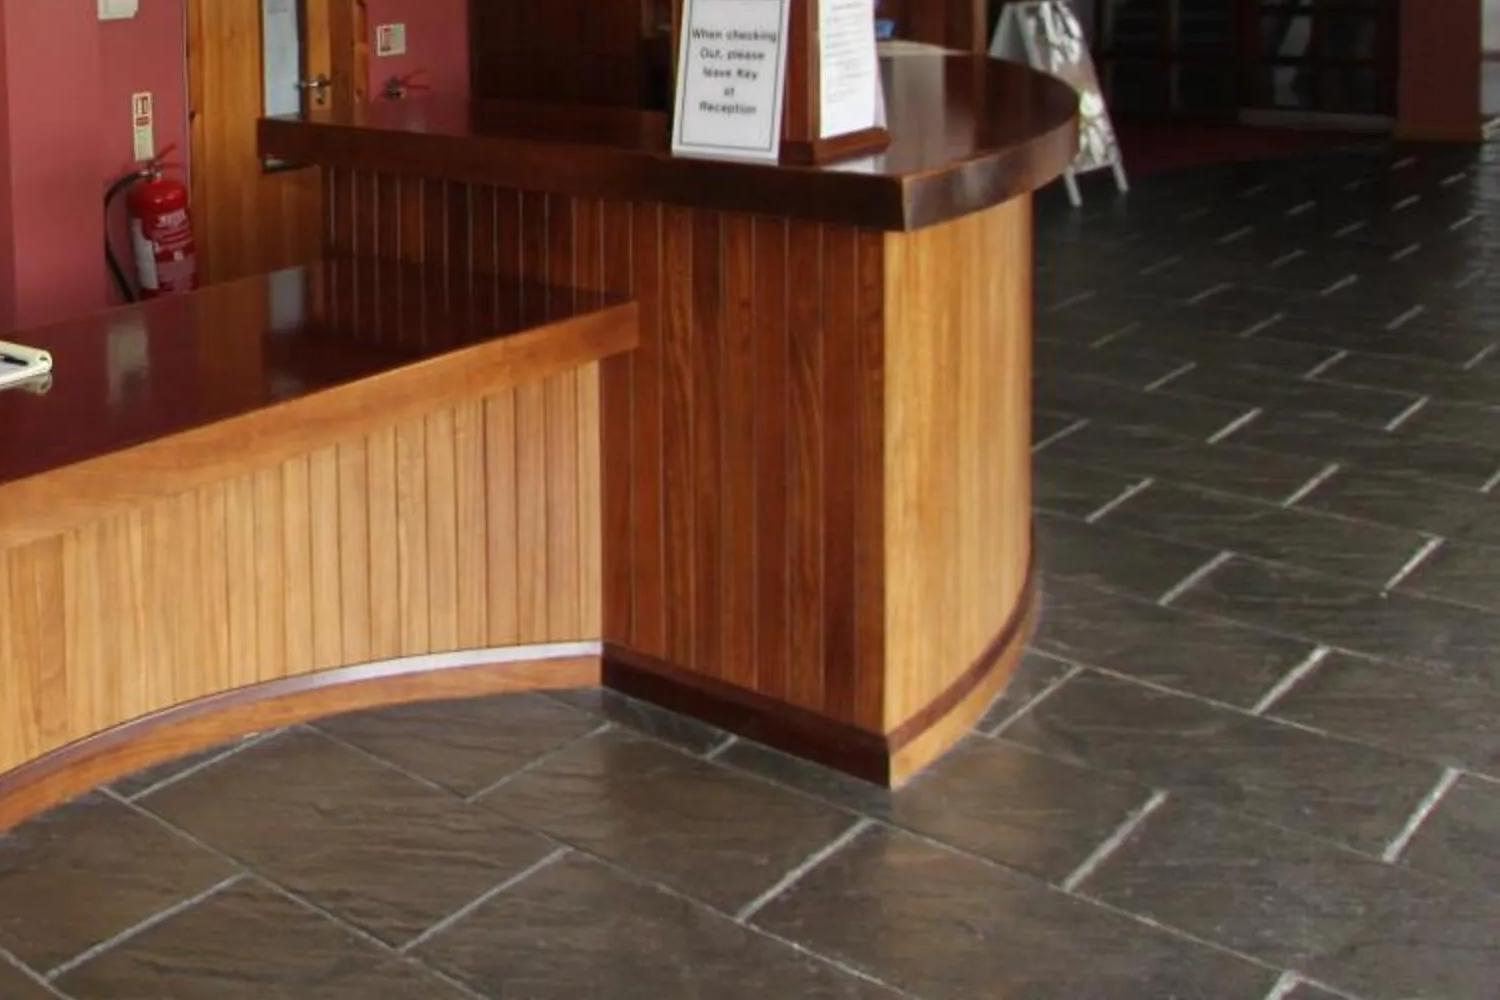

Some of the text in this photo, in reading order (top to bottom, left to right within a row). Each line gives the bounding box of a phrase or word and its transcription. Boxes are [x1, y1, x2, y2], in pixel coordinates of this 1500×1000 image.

[692, 28, 777, 43] When checking
[727, 48, 766, 61] please
[702, 67, 758, 80] leave Key
[723, 87, 735, 97] at
[699, 101, 757, 116] Reception
